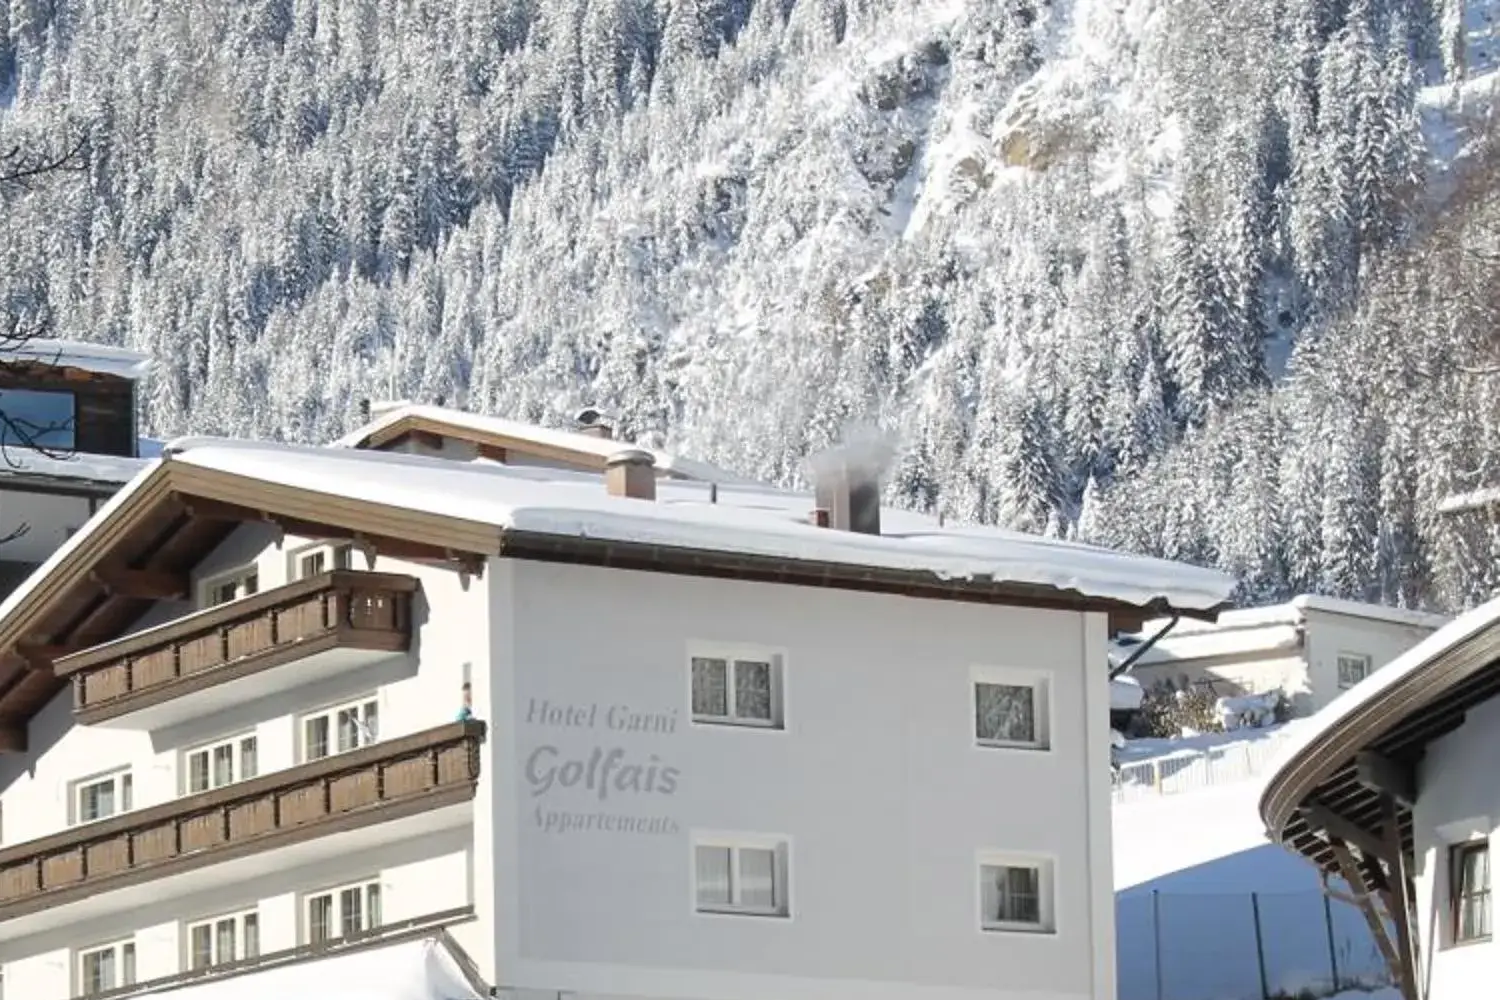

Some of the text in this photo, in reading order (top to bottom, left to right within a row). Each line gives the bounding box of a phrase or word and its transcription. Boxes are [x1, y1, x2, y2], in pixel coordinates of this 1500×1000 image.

[526, 698, 678, 734] Hotel Garni
[524, 745, 681, 800] Golfais
